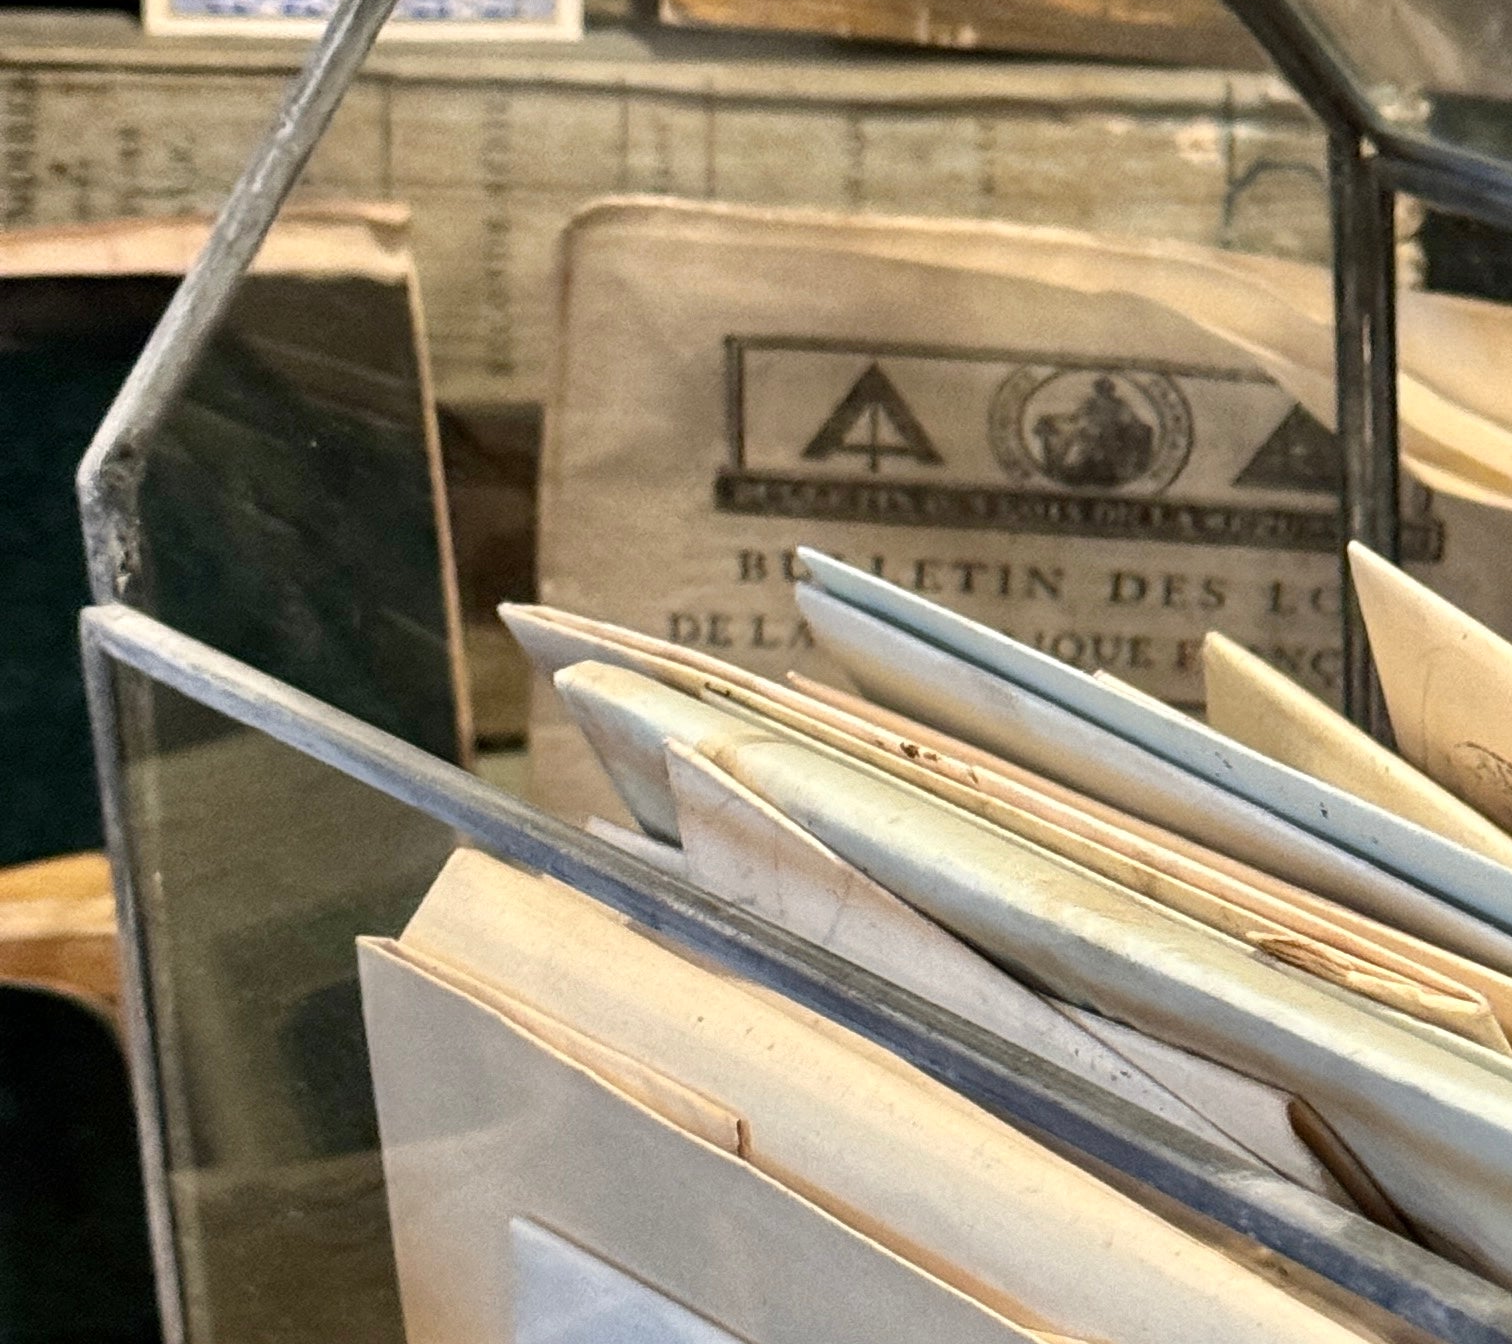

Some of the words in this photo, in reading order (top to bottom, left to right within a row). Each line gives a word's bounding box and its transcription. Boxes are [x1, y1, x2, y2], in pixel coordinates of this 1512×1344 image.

[736, 549, 1065, 600] BULETIN
[1110, 571, 1226, 608] DES
[667, 610, 734, 648] DE
